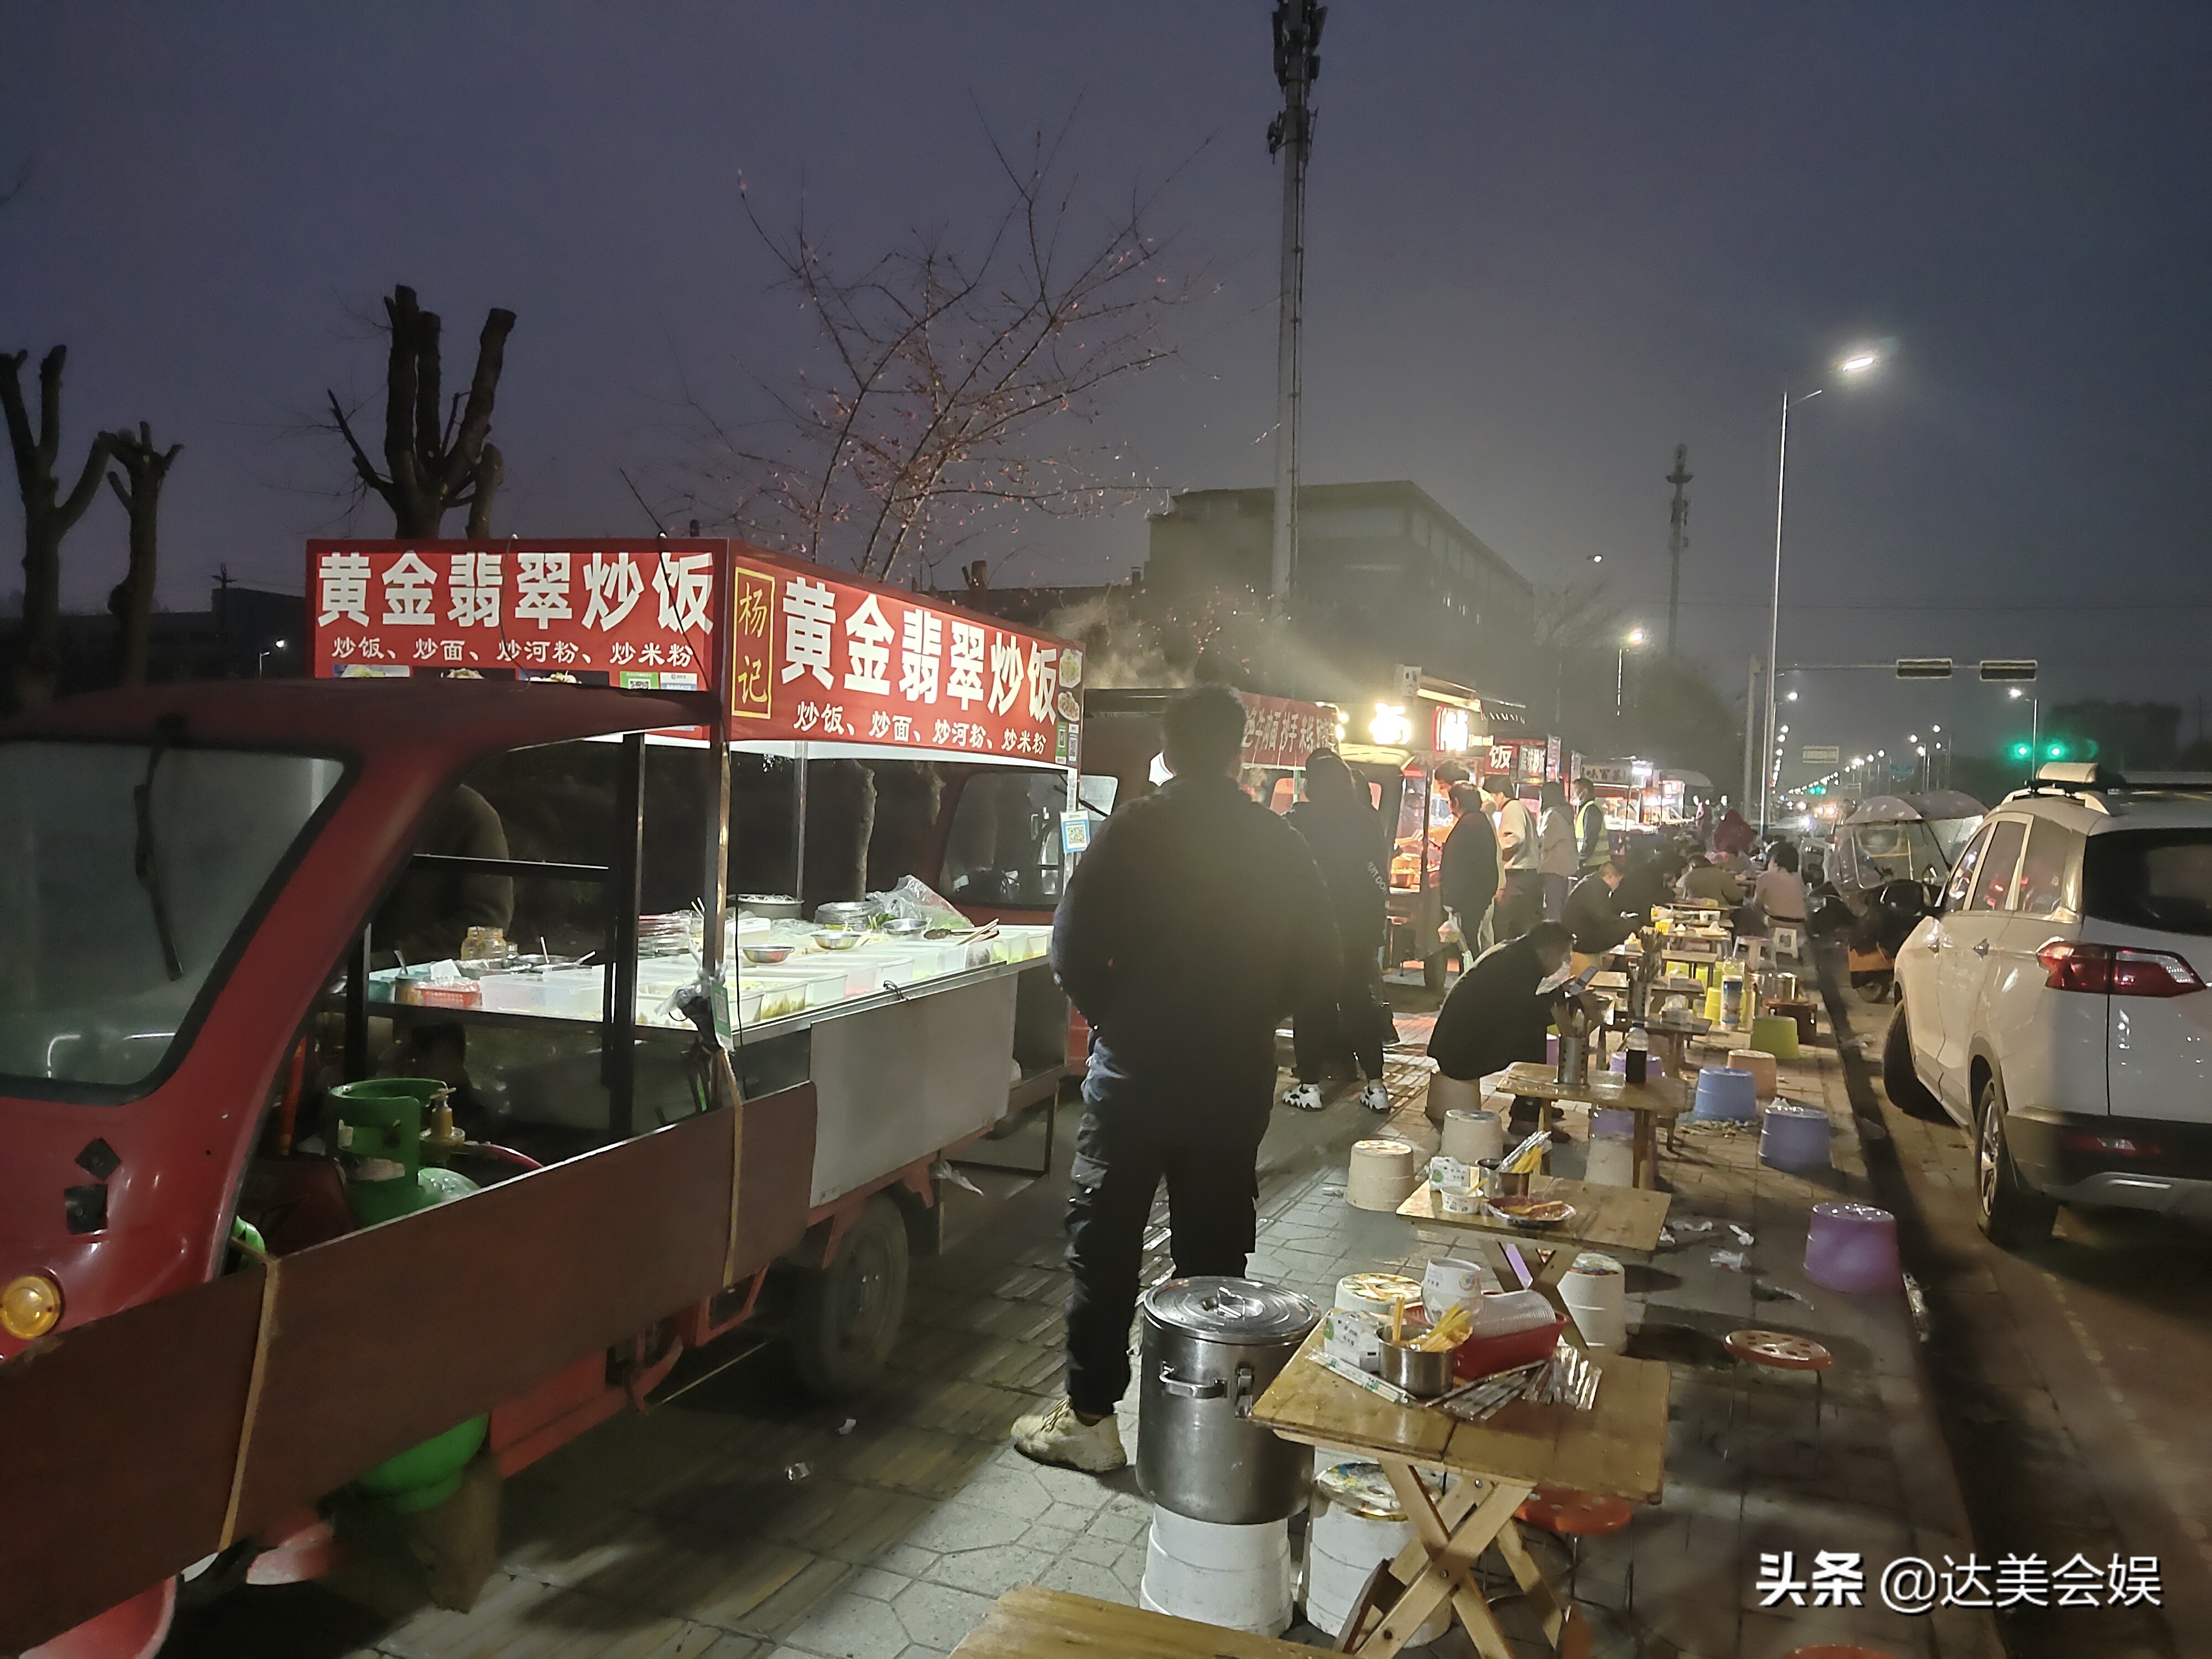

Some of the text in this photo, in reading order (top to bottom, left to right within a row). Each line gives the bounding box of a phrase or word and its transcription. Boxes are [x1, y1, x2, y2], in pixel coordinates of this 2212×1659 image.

[317, 551, 713, 634] 黄金翡翠炒饭
[738, 583, 769, 705] 杨记
[781, 577, 1057, 725] 黄金翡翠炒饭
